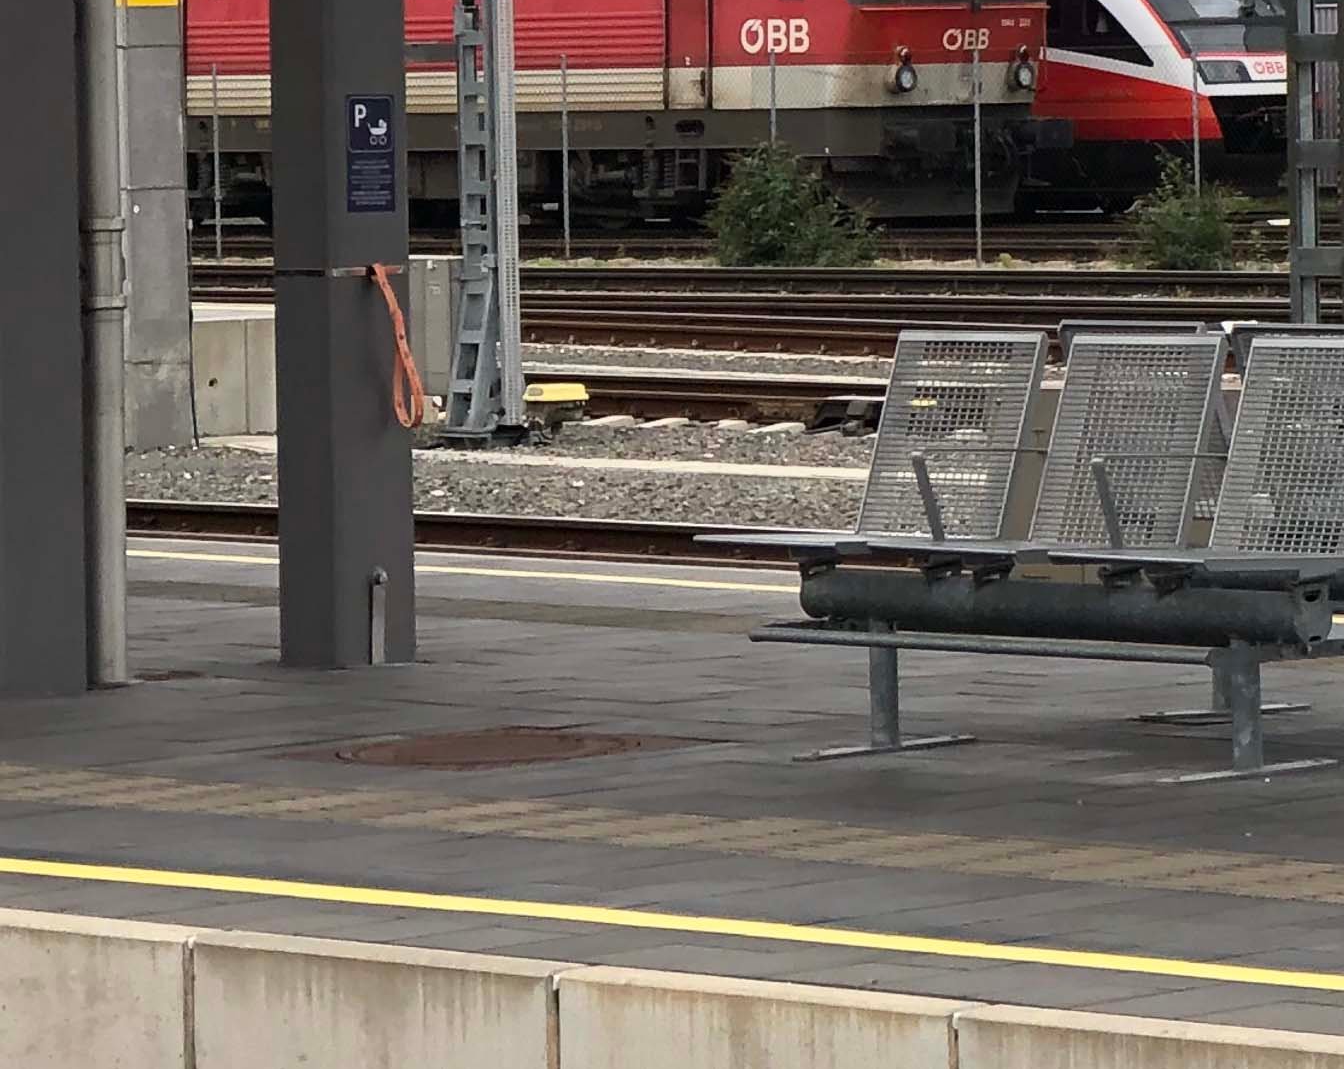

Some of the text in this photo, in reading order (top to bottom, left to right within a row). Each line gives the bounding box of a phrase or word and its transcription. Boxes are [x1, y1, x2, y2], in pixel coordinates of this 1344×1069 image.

[740, 18, 810, 54] ÖBB
[942, 28, 991, 51] ÖBB
[354, 103, 367, 128] P
